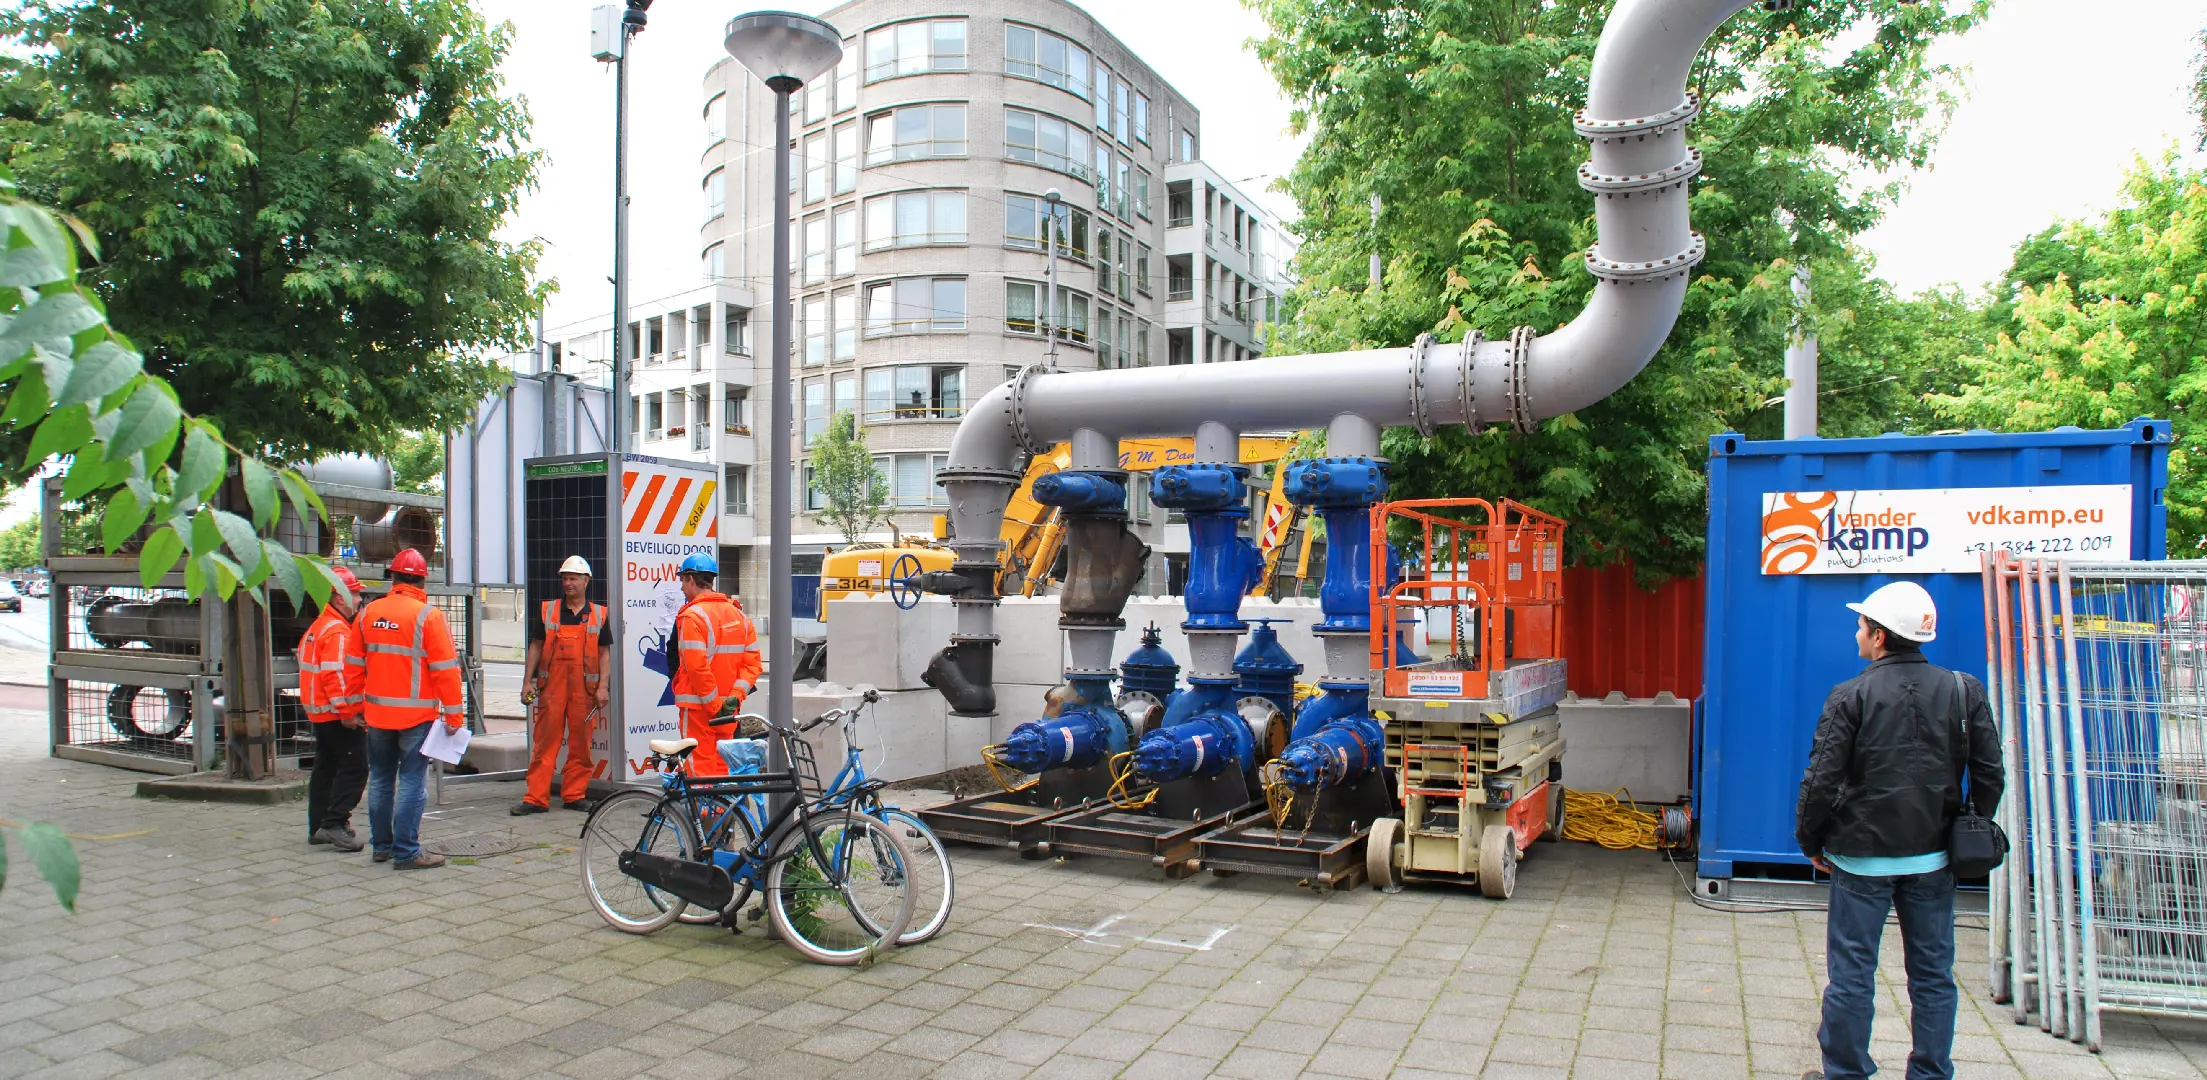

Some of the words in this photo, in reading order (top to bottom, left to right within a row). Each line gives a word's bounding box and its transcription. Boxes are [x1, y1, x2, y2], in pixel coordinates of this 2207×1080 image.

[1137, 451, 1157, 463] M.
[1165, 449, 1195, 461] Dan
[689, 501, 706, 529] Solar
[1837, 507, 1917, 527] vander
[1967, 505, 2104, 528] vdkamp.eu
[1828, 508, 1929, 557] kamp
[626, 541, 681, 555] BEVEILIGD
[683, 544, 713, 557] DOOR
[2001, 541, 2036, 554] 384
[2041, 538, 2073, 553] 222
[2080, 535, 2112, 551] 009
[1828, 558, 1854, 568] pump
[838, 578, 870, 590] 314
[627, 599, 657, 608] CAMER
[373, 620, 399, 630] mjo
